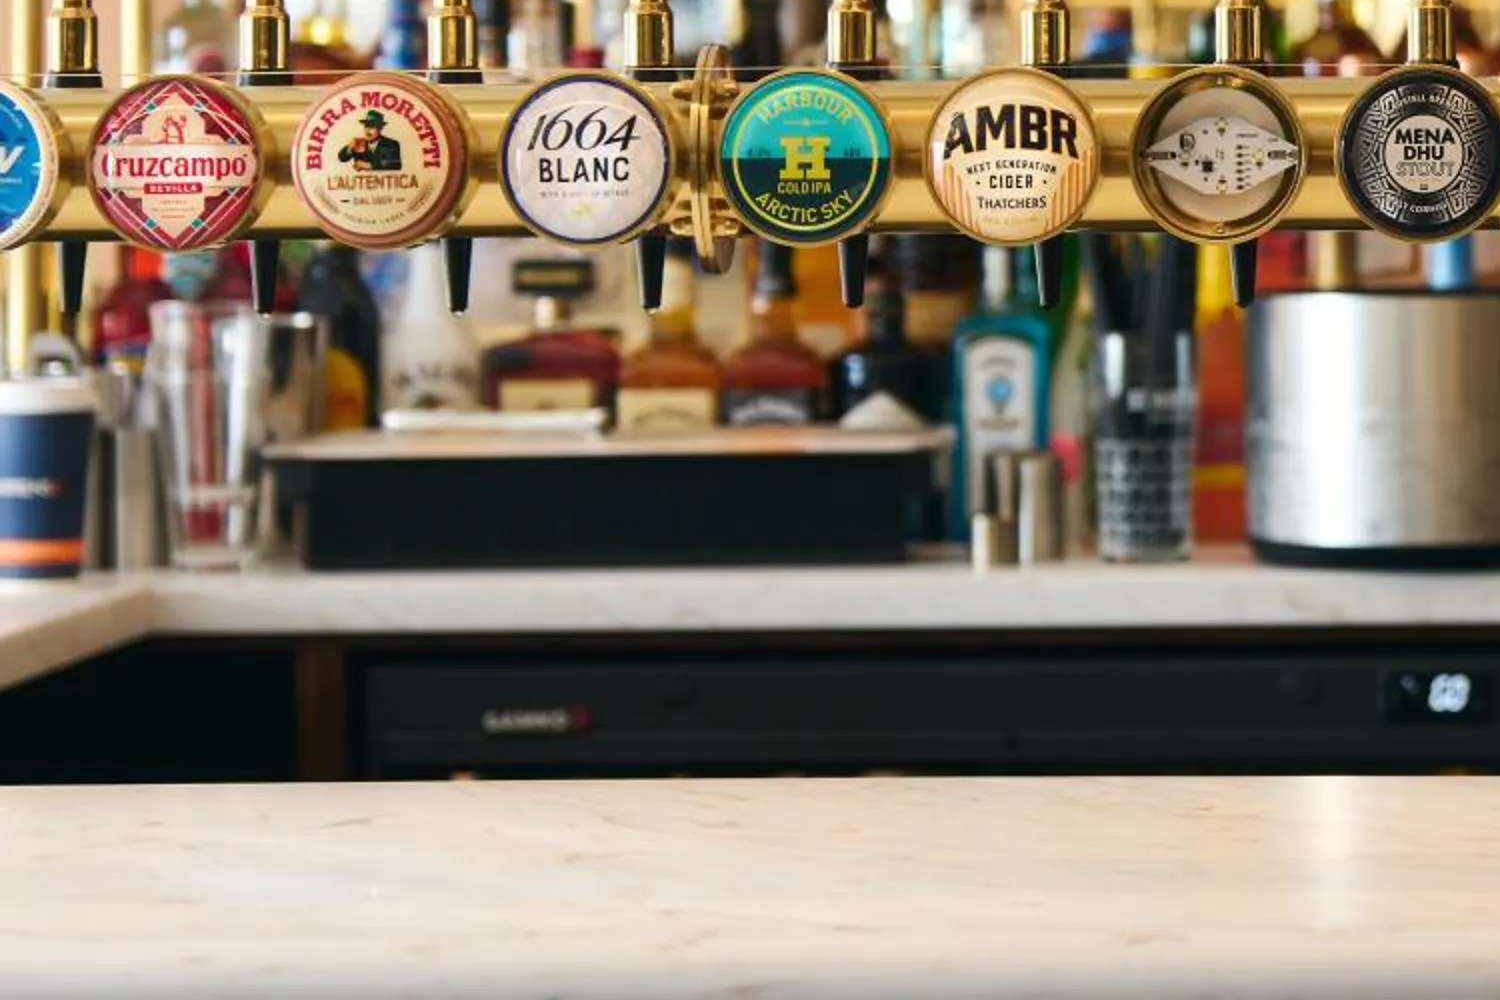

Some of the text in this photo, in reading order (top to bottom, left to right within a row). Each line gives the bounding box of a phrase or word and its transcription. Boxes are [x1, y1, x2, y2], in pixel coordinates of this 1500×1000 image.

[756, 90, 854, 125] HARBOUR
[306, 91, 441, 170] BIRRA MORETTI
[527, 105, 641, 152] 1664
[943, 103, 1079, 160] AMBR
[1394, 128, 1455, 145] MENA
[1403, 146, 1445, 161] DHU
[539, 156, 630, 183] BLANC
[995, 159, 1057, 174] GENERATION
[1395, 162, 1456, 177] STOUT
[327, 174, 419, 190] L'AUTENTICA
[777, 181, 832, 195] COLD IPA
[988, 175, 1034, 189] CIDER
[755, 188, 854, 223] ARCTIC SKY
[977, 196, 1047, 209] THATCHERS
